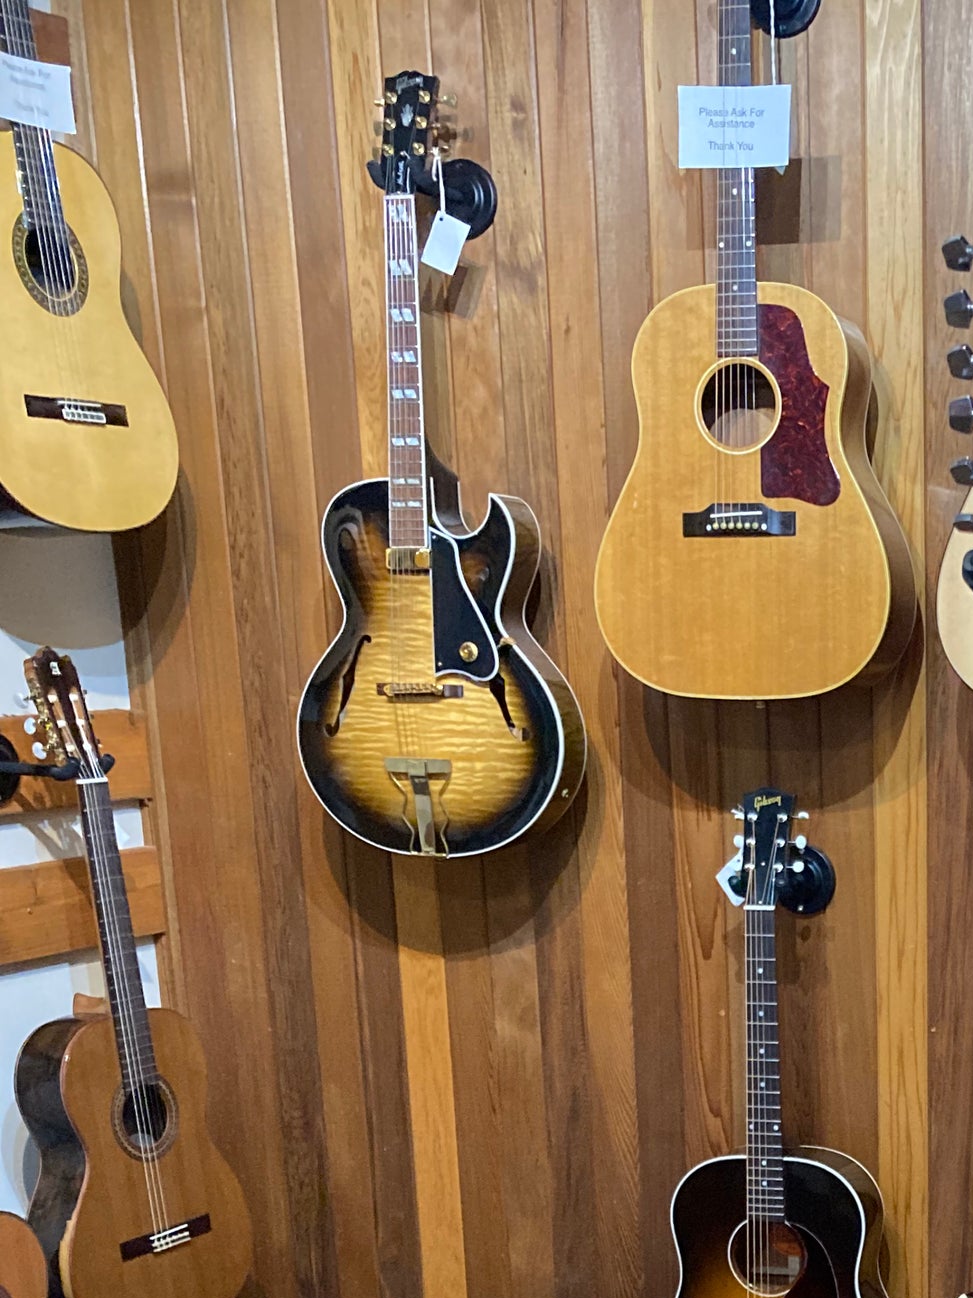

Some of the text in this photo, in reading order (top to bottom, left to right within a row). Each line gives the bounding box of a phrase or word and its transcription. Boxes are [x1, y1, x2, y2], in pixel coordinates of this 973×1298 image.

[699, 107, 765, 117] Please Ask For
[707, 118, 755, 128] Assistance
[708, 141, 754, 151] Thank You
